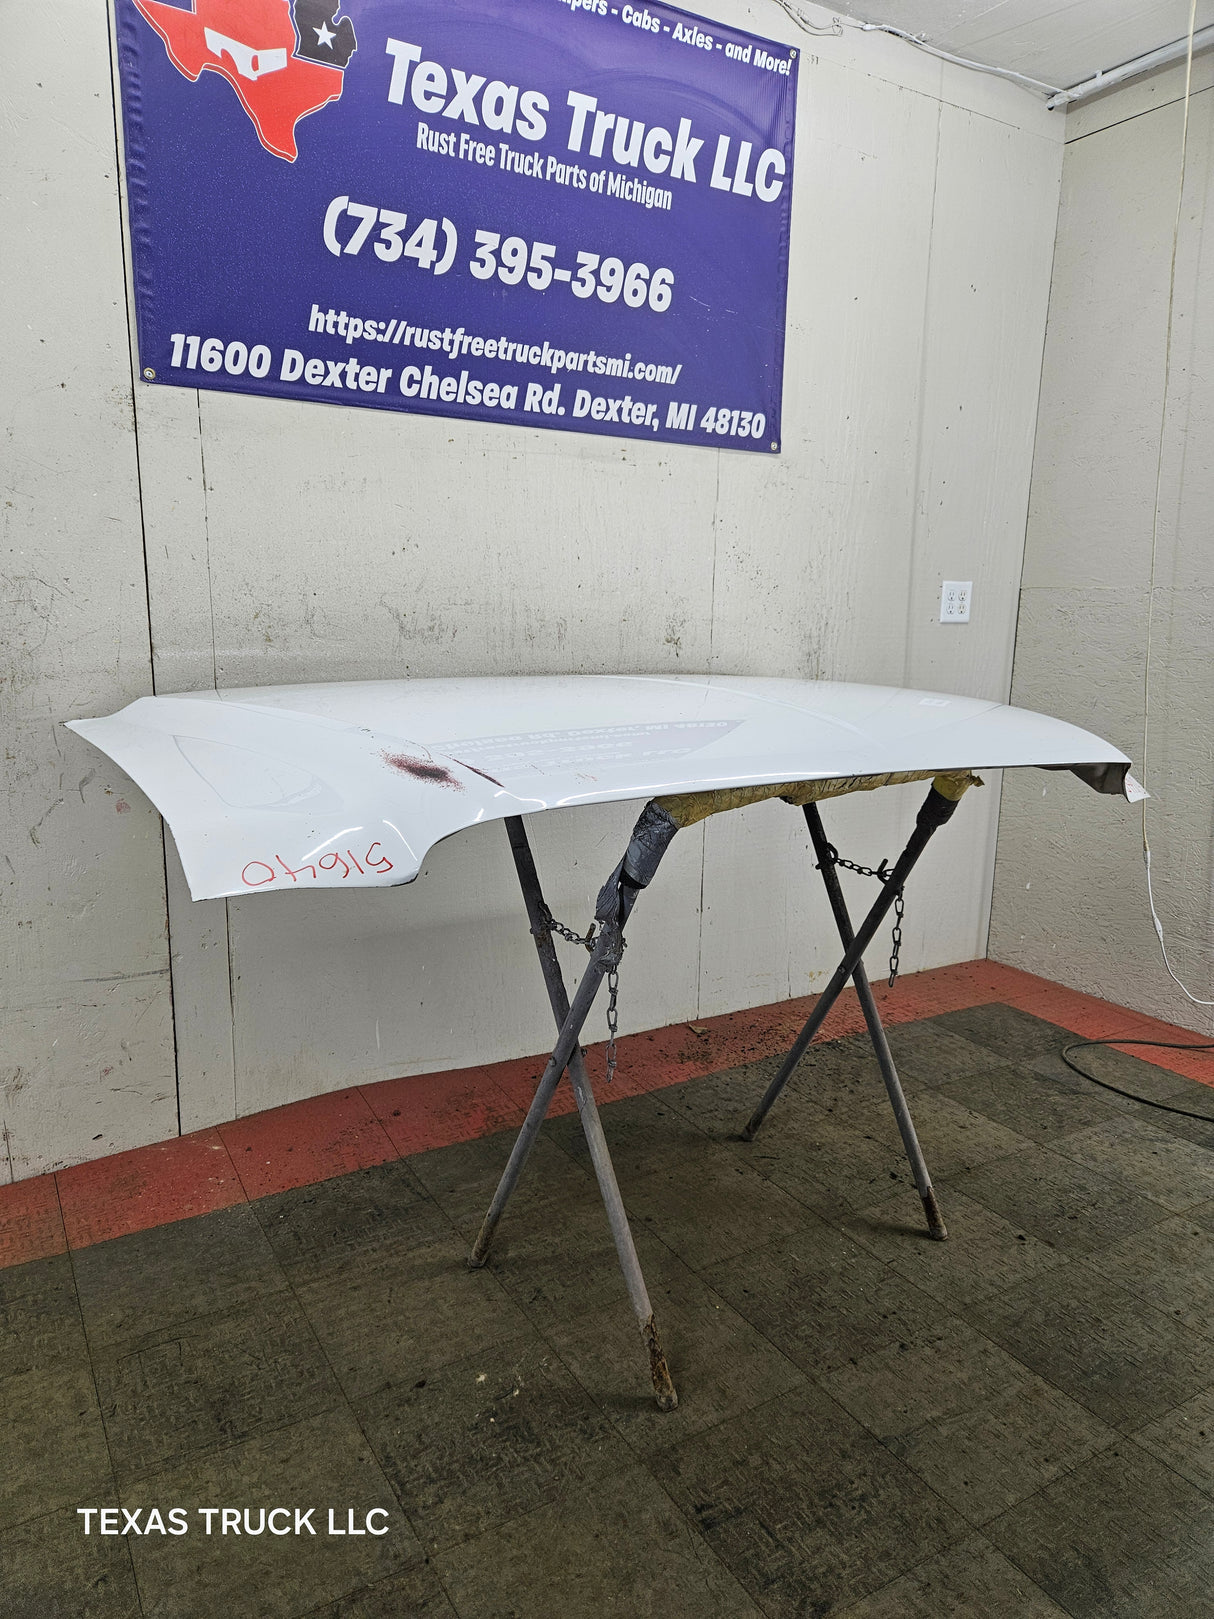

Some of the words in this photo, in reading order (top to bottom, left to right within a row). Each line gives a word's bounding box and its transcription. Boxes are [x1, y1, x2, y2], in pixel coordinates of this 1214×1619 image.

[622, 5, 660, 32] Cabs
[672, 23, 713, 50] Axles
[725, 43, 752, 63] and
[754, 49, 792, 75] More!
[385, 37, 549, 141] Texas
[566, 90, 704, 183] Truck
[710, 135, 785, 202] LLC
[417, 122, 456, 156] Rust
[459, 133, 495, 166] Free
[500, 143, 544, 178] Truck
[546, 156, 587, 189] Parts
[590, 170, 606, 193] of
[607, 172, 672, 210] Michigan
[324, 196, 457, 274] (734)
[470, 230, 674, 312] 395-3966
[171, 334, 271, 377] 11600
[280, 349, 392, 392] Dexter
[400, 366, 518, 409] Chelsea
[524, 383, 565, 415] Rd.
[573, 390, 659, 431] Dexter,
[666, 402, 697, 430] MI
[701, 407, 765, 438] 48130
[308, 303, 682, 385] https://rustfreetruckpartsmi.com/
[242, 842, 393, 886] 51640
